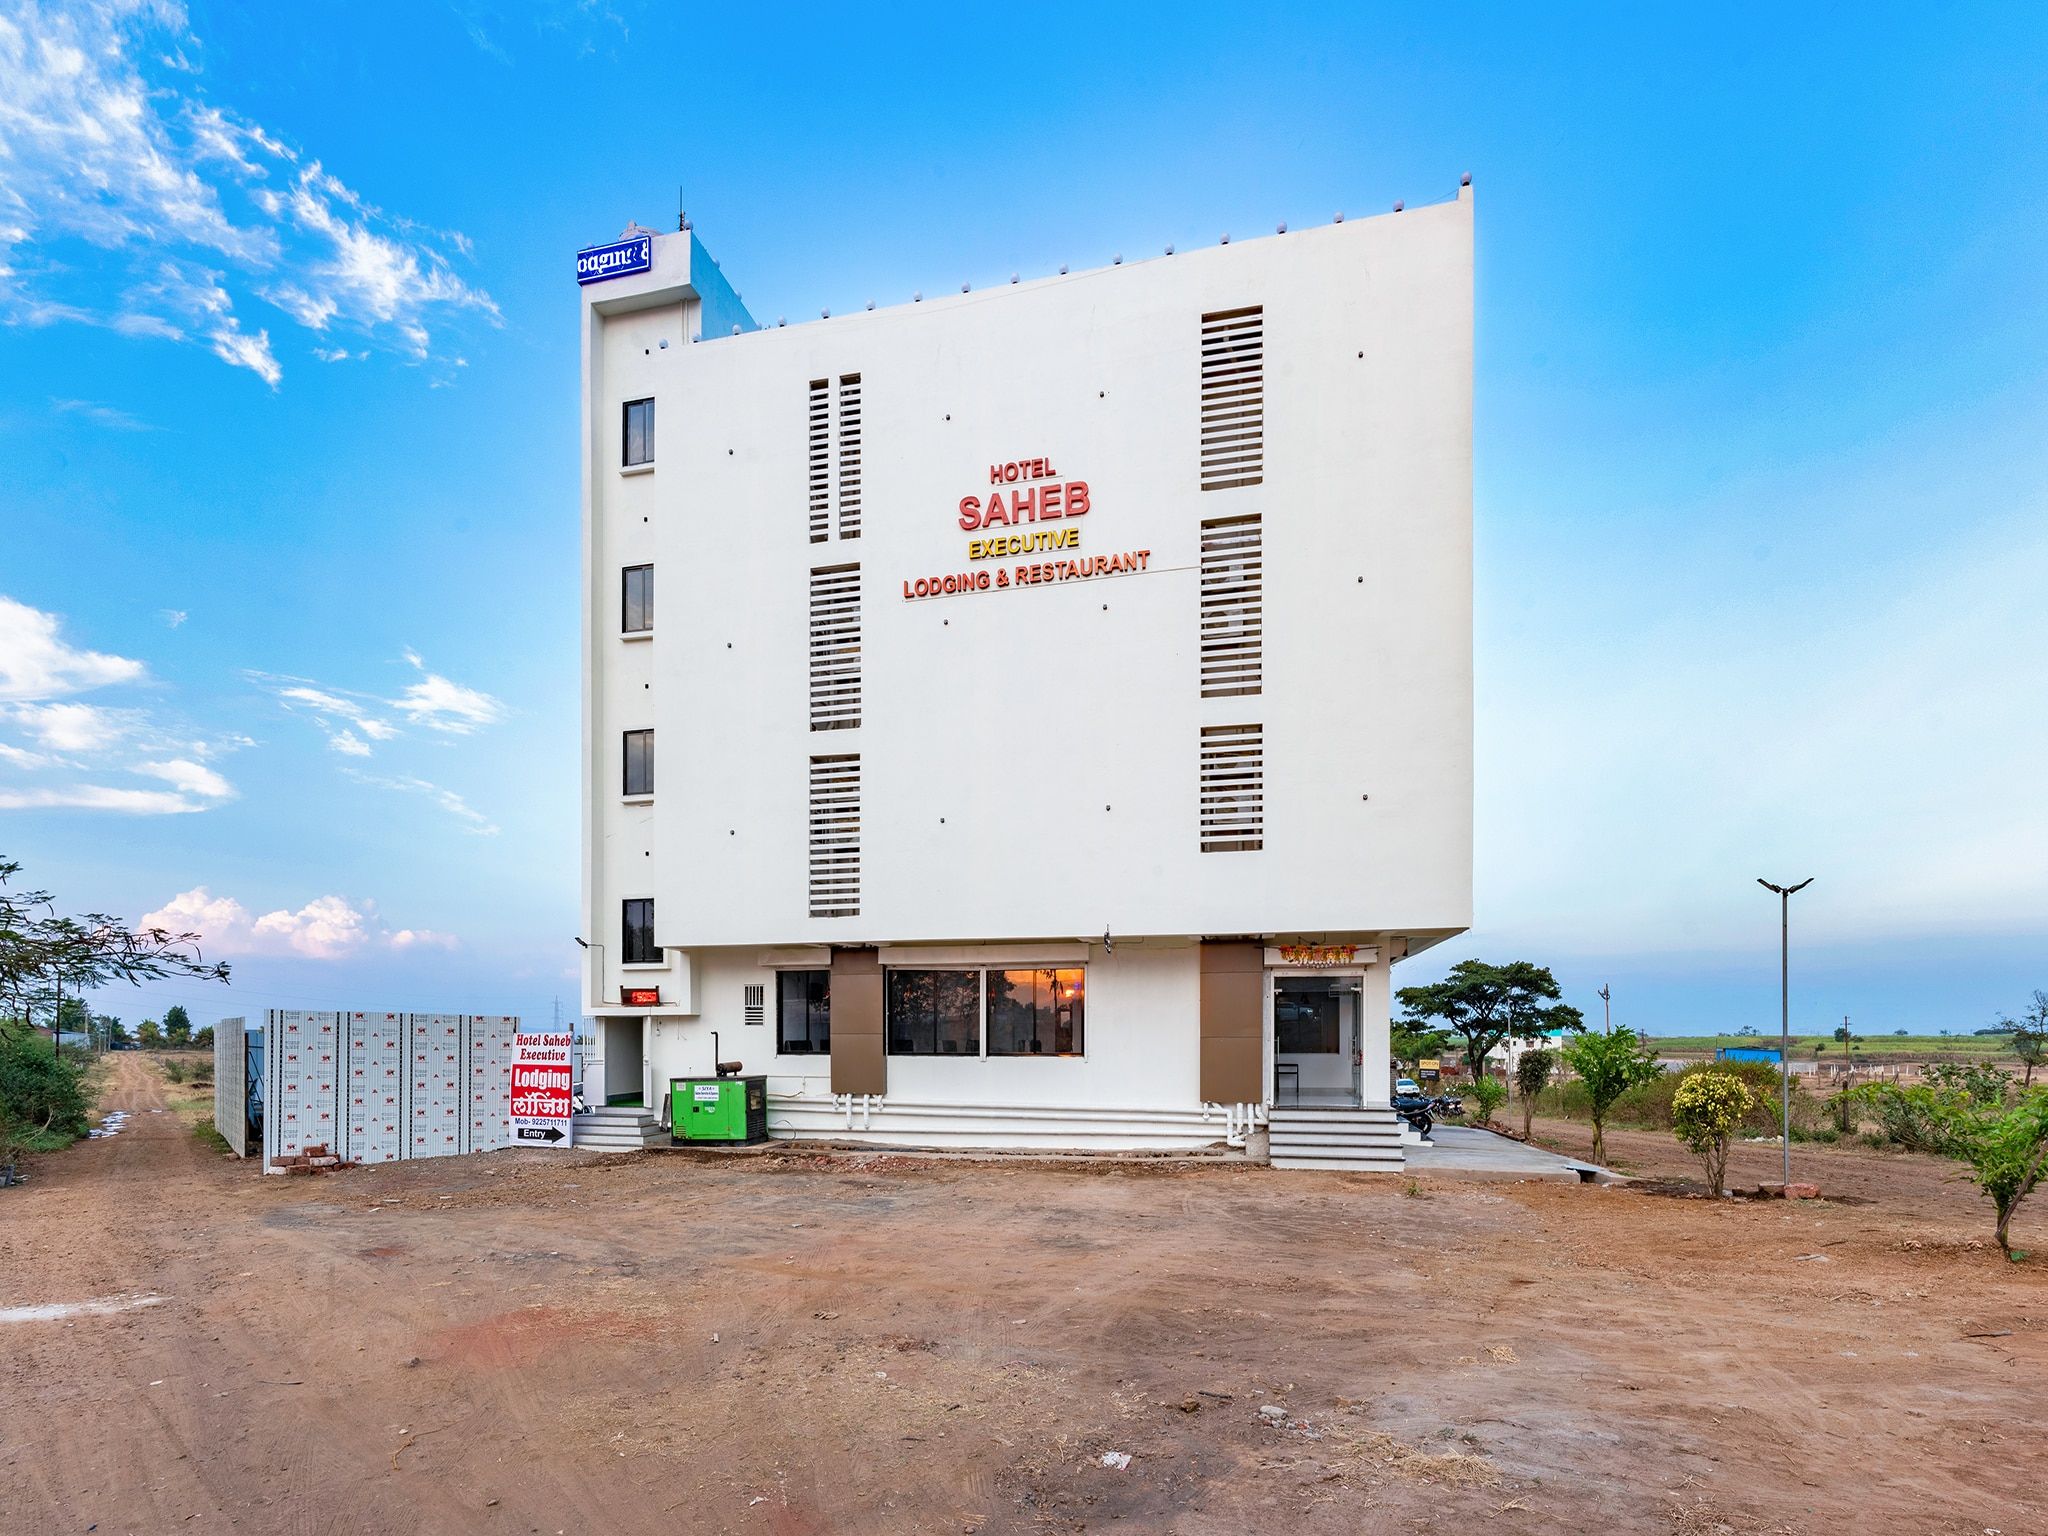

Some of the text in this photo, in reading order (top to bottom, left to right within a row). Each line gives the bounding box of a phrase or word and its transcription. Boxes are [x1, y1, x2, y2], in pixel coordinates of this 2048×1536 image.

[990, 457, 1056, 484] HOTEL
[958, 481, 1090, 530] SAHEB
[969, 528, 1080, 559] EXECUTIVE
[903, 550, 1151, 598] LODGING & RESTAURANT
[516, 1034, 541, 1046] Hotel
[543, 1034, 571, 1046] Saheb
[520, 1048, 566, 1060] Executive
[514, 1068, 570, 1091] Lodging
[512, 1091, 570, 1116] लॉजिंग
[532, 1118, 567, 1126] 9225711711
[523, 1129, 546, 1140] Entry
